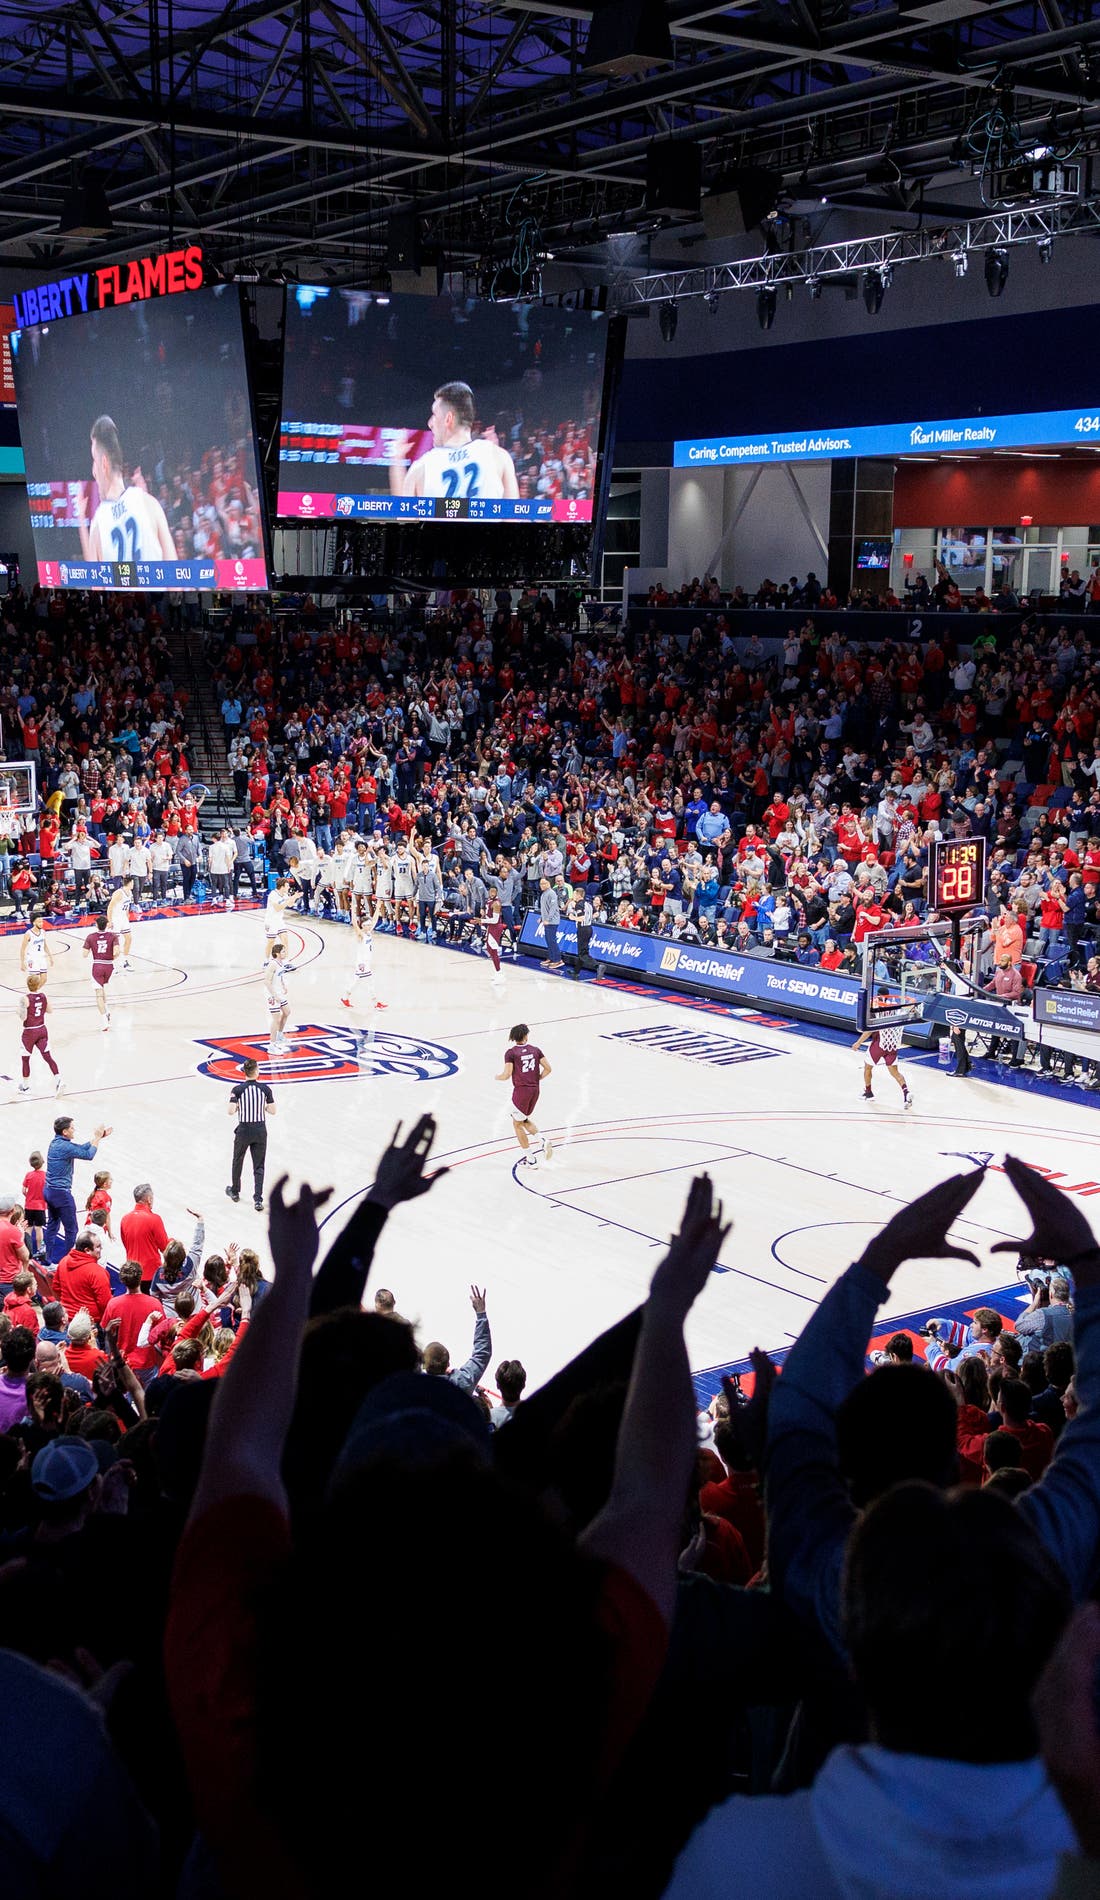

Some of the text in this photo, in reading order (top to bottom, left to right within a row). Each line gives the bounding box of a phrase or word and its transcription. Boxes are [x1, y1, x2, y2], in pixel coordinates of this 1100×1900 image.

[13, 246, 203, 329] LIBERTY FLAMES
[914, 426, 996, 444] Karl Miller Realty
[689, 438, 852, 460] Caring. Competent. Trusted Advisors.
[357, 501, 393, 511] LIBERTY
[400, 502, 410, 512] 31
[444, 499, 461, 509] 1:39
[492, 504, 501, 513] 31
[514, 504, 530, 514] EKU
[445, 509, 458, 518] 1ST
[69, 568, 88, 579] LIBERTY
[90, 569, 98, 579] 31
[118, 564, 131, 576] 1:39
[155, 568, 164, 580] 31
[175, 568, 191, 580] EKU
[200, 569, 215, 578] EKU
[910, 619, 922, 638] 2
[951, 845, 977, 865] 1:39
[943, 866, 972, 901] 28
[678, 954, 745, 982] Send Relief
[767, 974, 787, 990] Text
[787, 979, 819, 997] SEND
[1057, 1003, 1099, 1019] Send Relief
[968, 1016, 1021, 1034] MOTOR WORLD
[522, 1058, 536, 1073] 24
